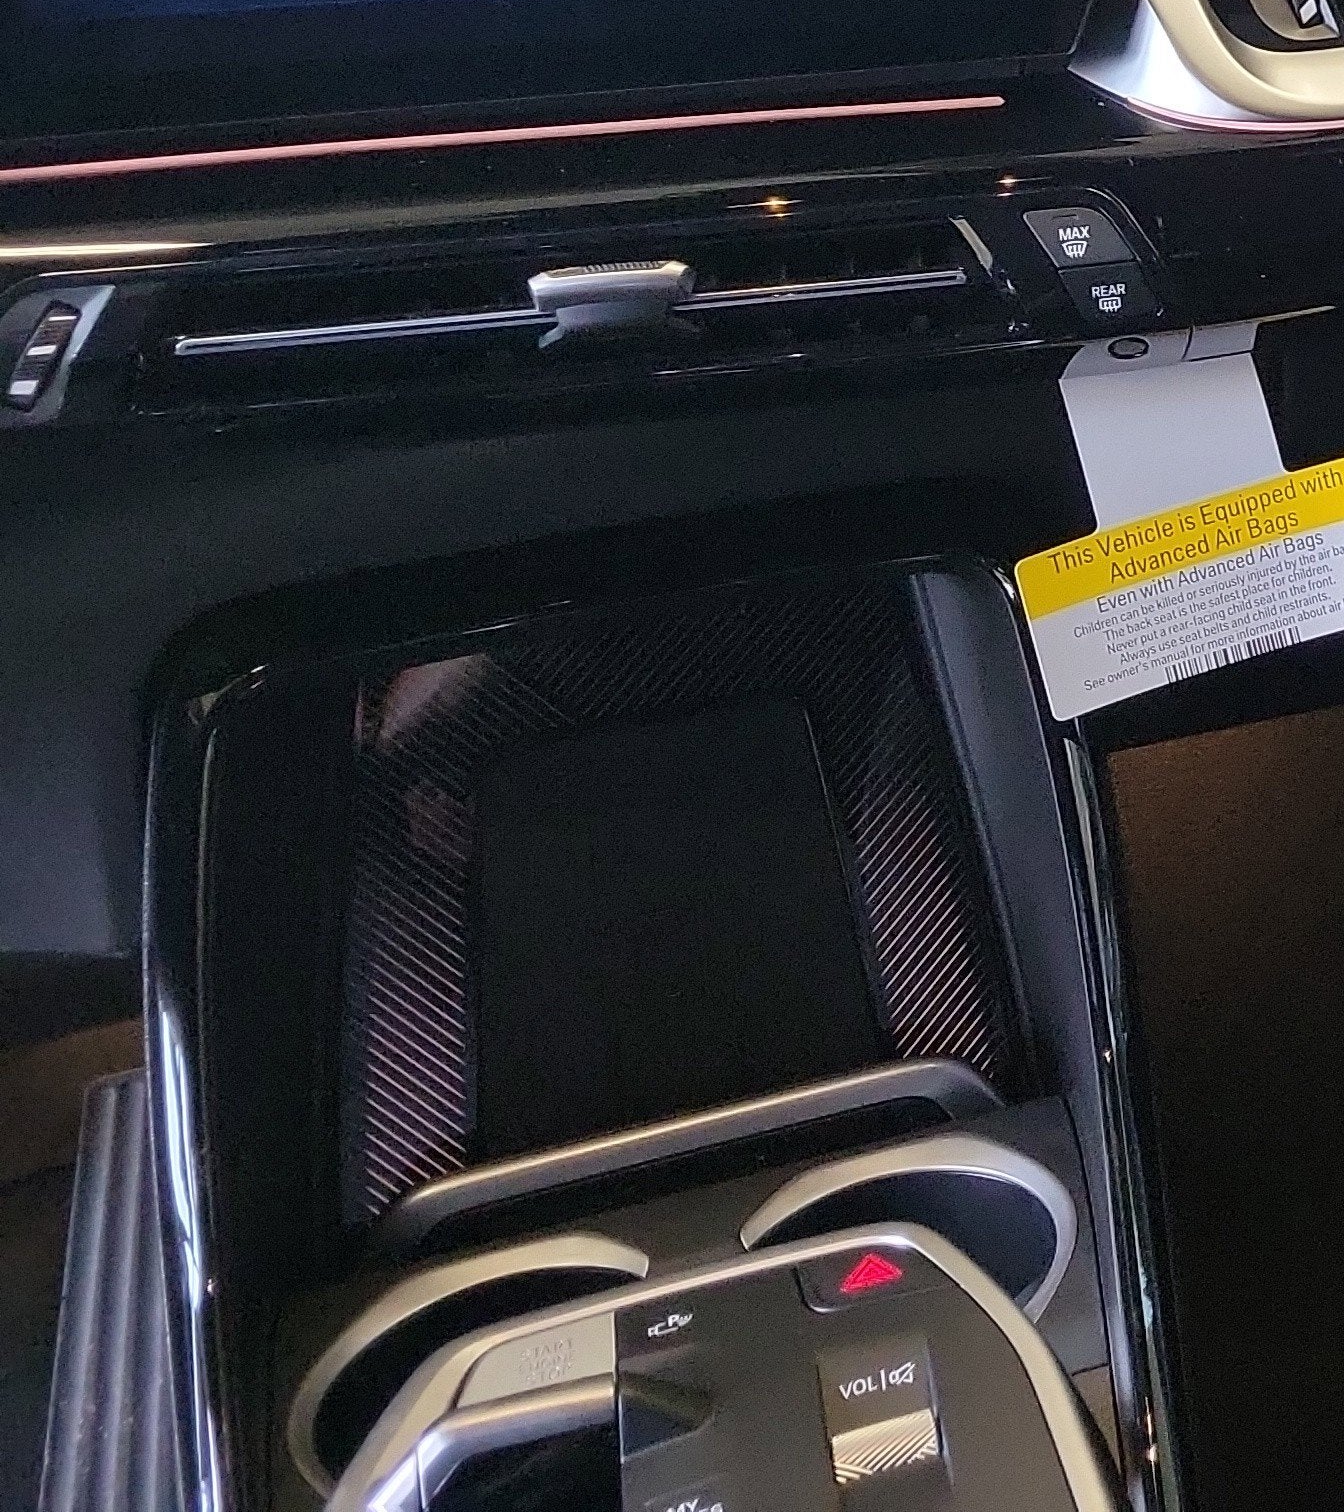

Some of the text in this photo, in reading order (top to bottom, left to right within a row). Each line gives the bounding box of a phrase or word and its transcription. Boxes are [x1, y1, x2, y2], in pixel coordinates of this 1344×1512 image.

[1058, 225, 1091, 241] MAX
[1091, 283, 1126, 299] REAR
[1047, 468, 1343, 574] This Vehicle is Equipped with
[1111, 512, 1299, 583] Advanced Air Bags
[1073, 616, 1119, 638] Children
[1120, 609, 1140, 622] can
[1140, 604, 1156, 615] be
[1155, 592, 1185, 610] killed
[1186, 590, 1197, 601] or
[1198, 574, 1245, 597] seriously
[1246, 561, 1283, 582] injured
[1283, 559, 1297, 572] by
[1298, 554, 1316, 566] the
[1318, 549, 1331, 561] air
[1096, 533, 1324, 613] Even with Advanced Air Bags
[1103, 564, 1333, 641] The back seat is the safest place for children.
[1083, 677, 1106, 691] See
[1107, 662, 1149, 683] owner's
[1150, 645, 1189, 668] manual
[1190, 643, 1205, 655] for
[1207, 634, 1235, 650] more
[1236, 615, 1296, 640] information
[1297, 605, 1327, 622] about
[1328, 601, 1341, 613] air
[1106, 575, 1337, 655] Never put a rear-facing child seat in the front.
[1120, 592, 1331, 666] Always use seat belts and child restraints.
[839, 1375, 878, 1400] VOL
